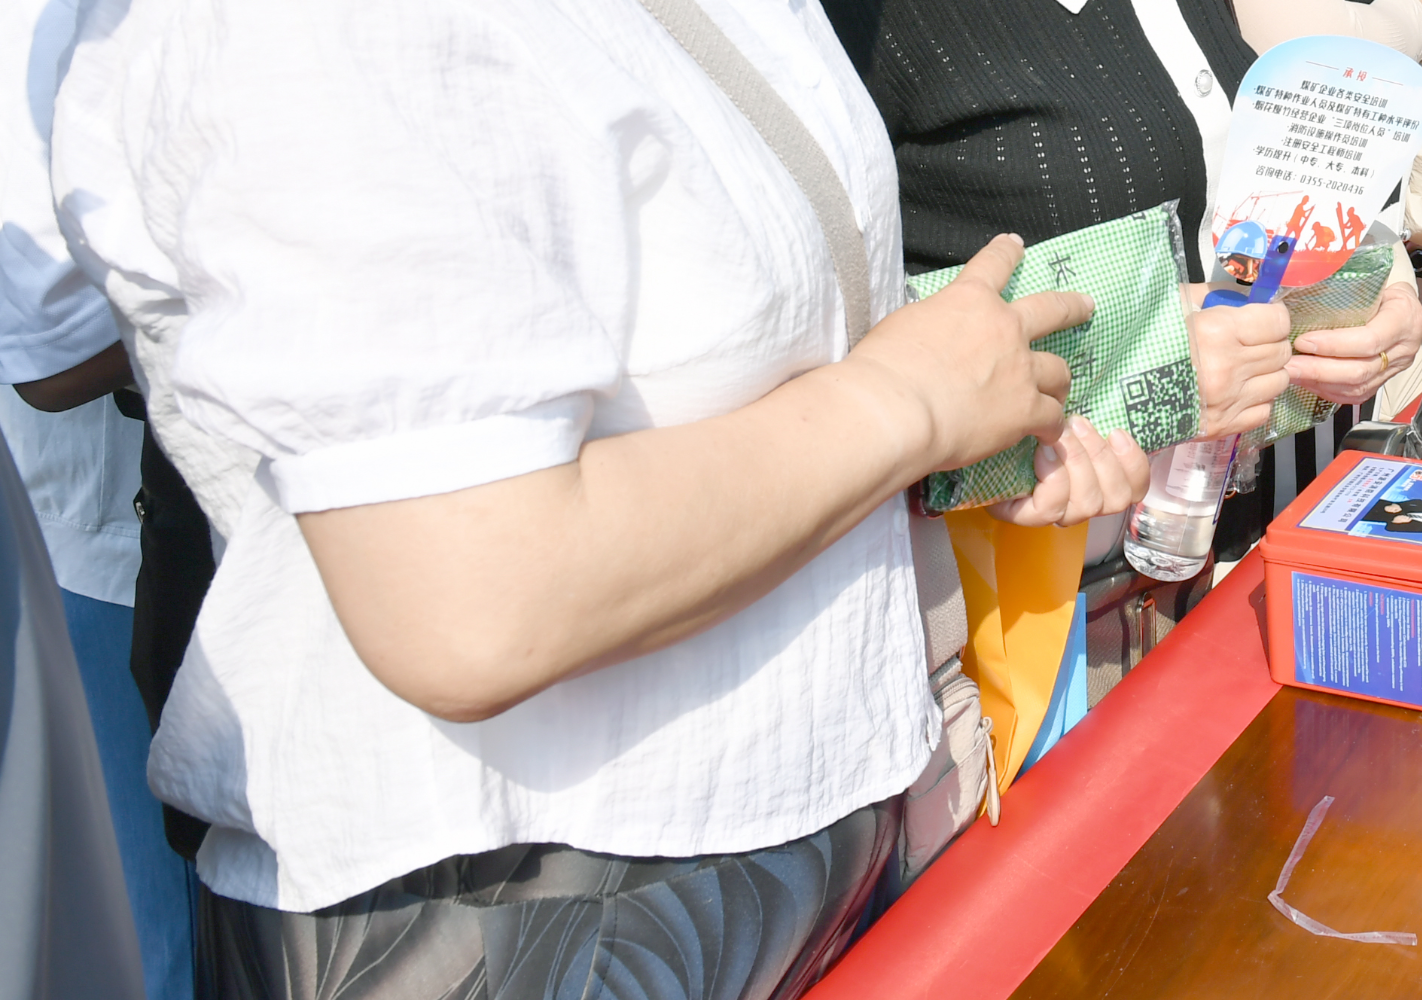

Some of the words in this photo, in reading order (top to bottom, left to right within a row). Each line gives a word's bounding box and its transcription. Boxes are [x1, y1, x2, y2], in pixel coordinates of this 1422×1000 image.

[1342, 66, 1368, 82] 承接
[1300, 80, 1388, 109] 煤矿企业各类安全培训
